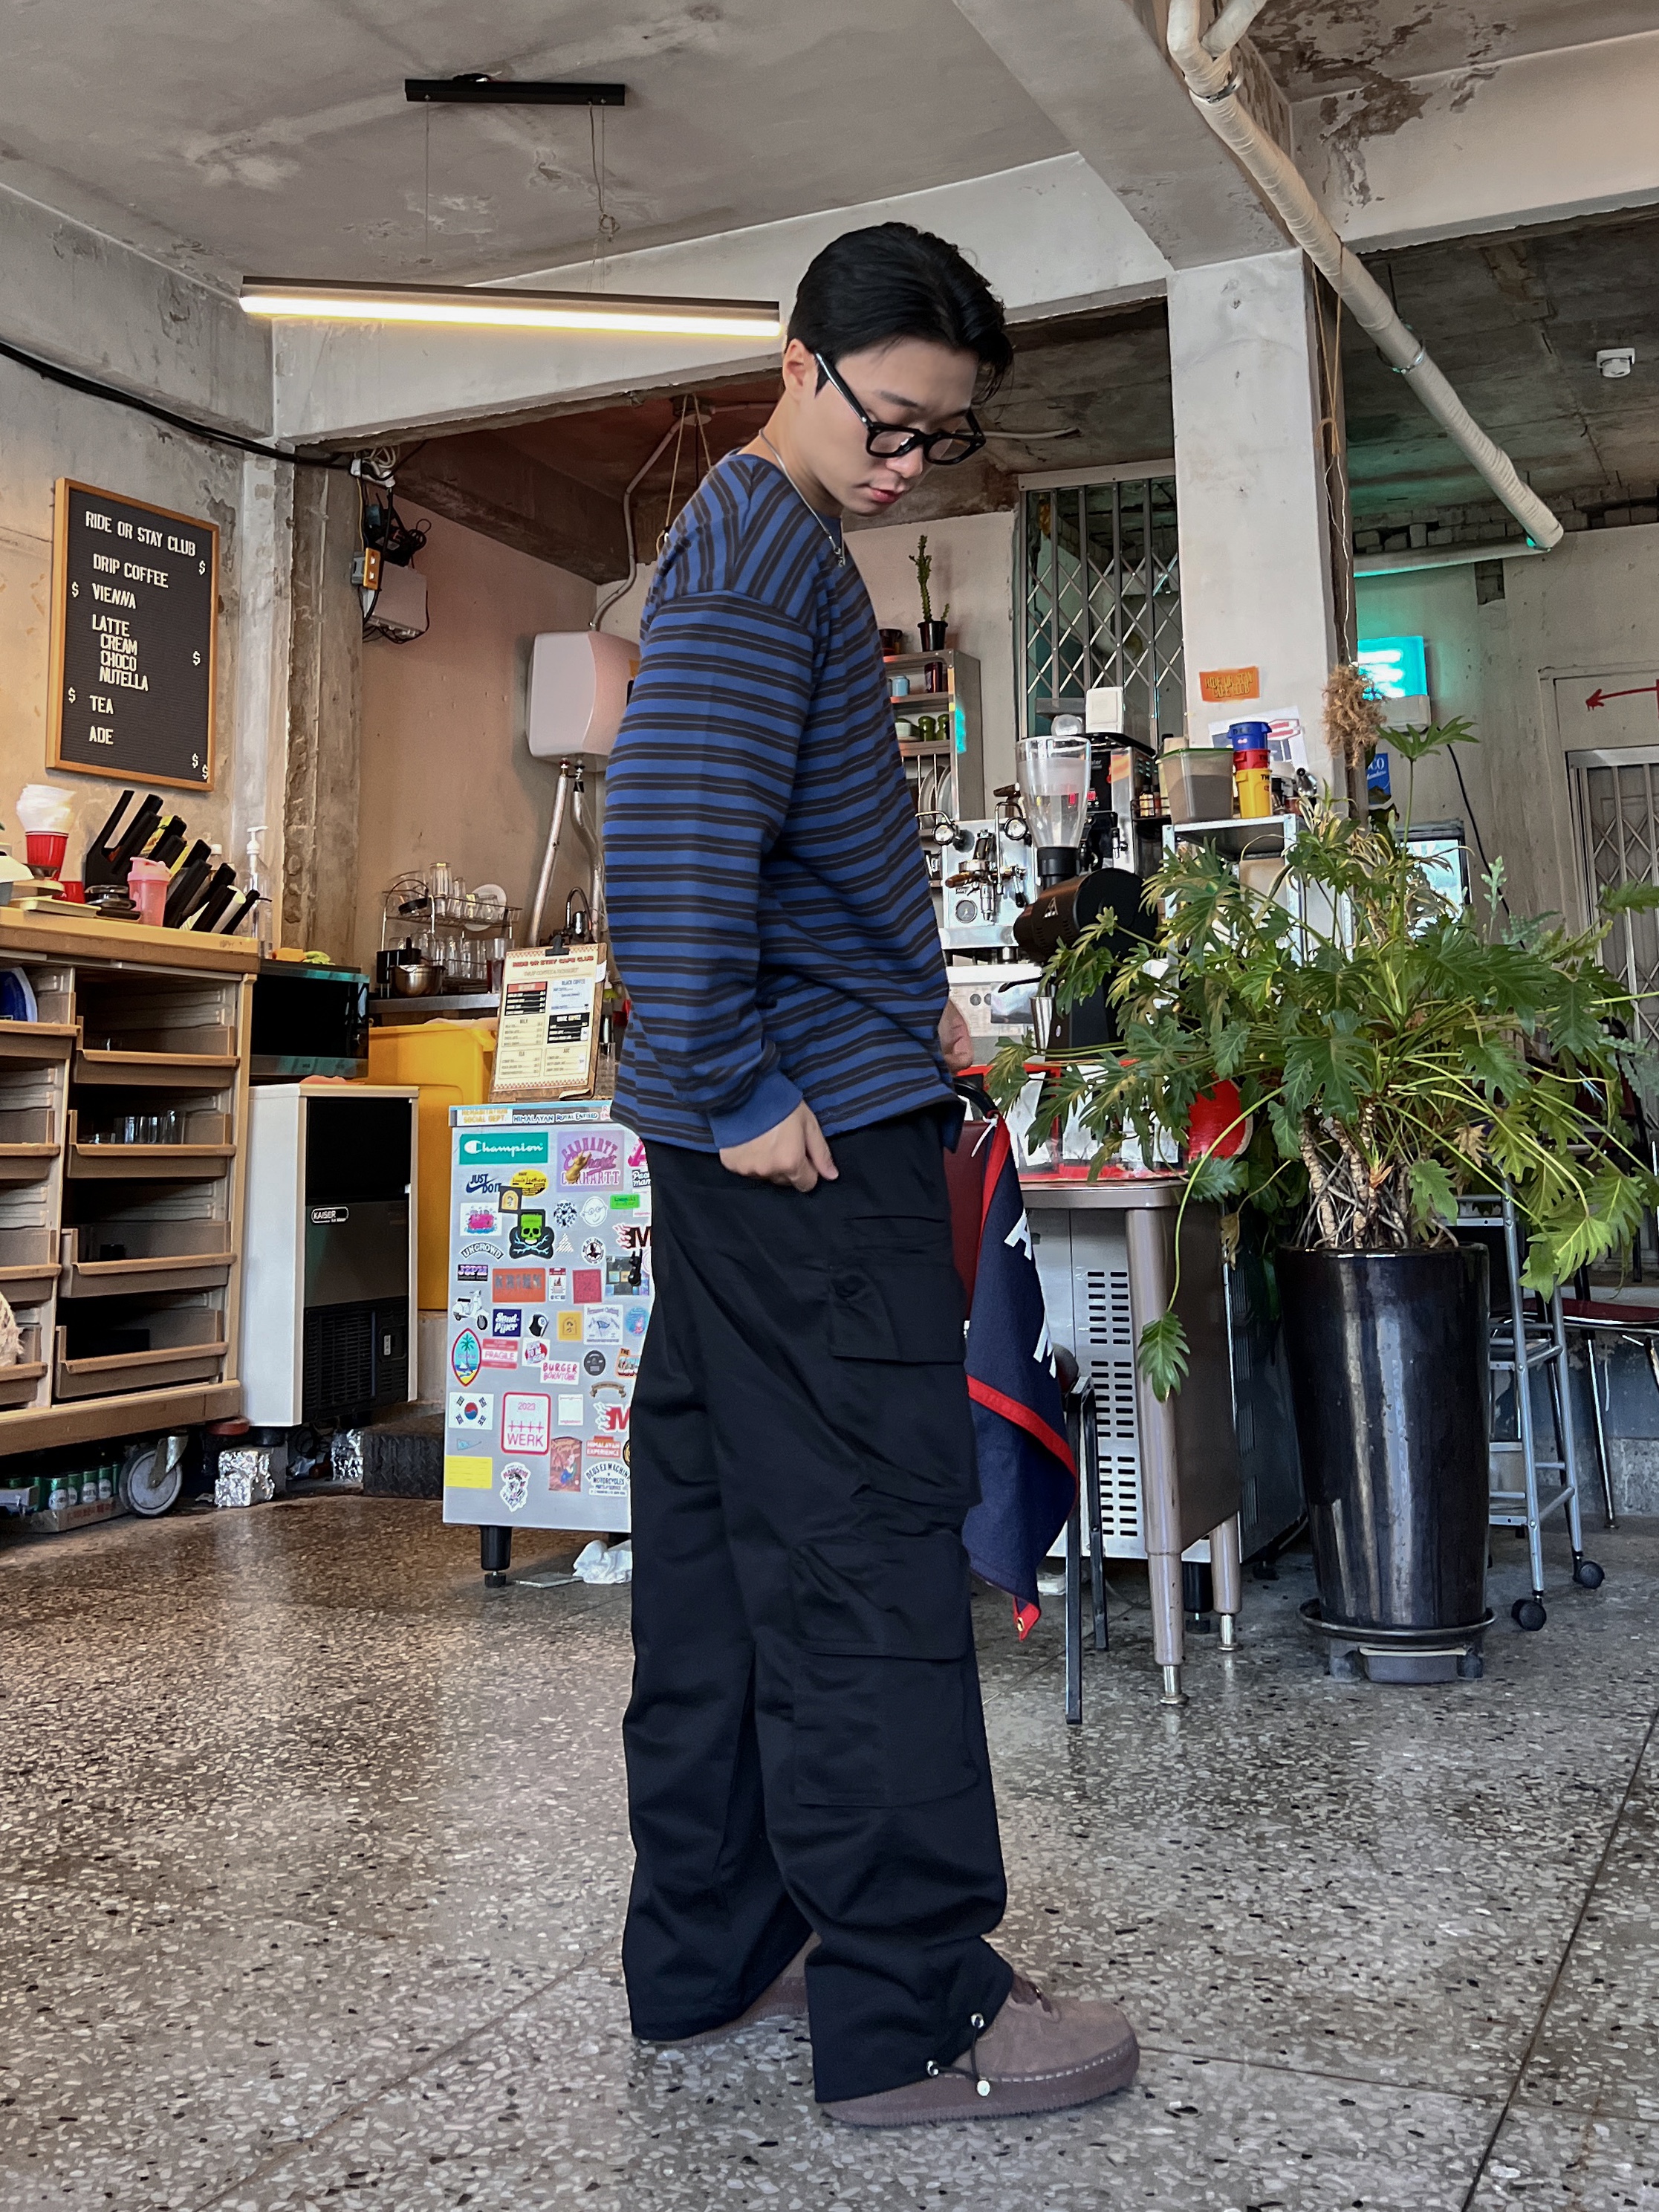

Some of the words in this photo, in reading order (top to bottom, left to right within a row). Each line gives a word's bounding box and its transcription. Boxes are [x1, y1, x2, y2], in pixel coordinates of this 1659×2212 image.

[85, 510, 112, 533] RIDE
[117, 520, 133, 539] OR
[137, 526, 163, 548] STAY
[167, 536, 196, 557] CLUB
[94, 554, 120, 575] DRIP
[123, 562, 169, 588] COFFEE
[198, 560, 206, 575] $
[71, 581, 79, 597] $
[92, 583, 137, 609] VIENNA
[92, 614, 130, 638] LATTE
[100, 634, 137, 655] CREAM
[100, 650, 137, 672] CHOCO
[192, 651, 201, 666] $
[100, 666, 149, 692] NUTELLA
[68, 687, 76, 704] $
[89, 695, 114, 715] TEA
[89, 725, 114, 745] ADE
[192, 753, 199, 768] $
[464, 1115, 485, 1123] SOCIAL
[513, 1115, 553, 1123] HIMALAYAN
[464, 1140, 543, 1157] Champion
[470, 1173, 489, 1184] JUST
[482, 1184, 493, 1193] DO
[314, 1210, 336, 1219] KAISER
[462, 1243, 502, 1259] UNCROWD
[485, 1351, 514, 1360] FRAGILE
[543, 1363, 577, 1373] BURGER
[507, 1433, 544, 1447] WERK
[586, 1466, 600, 1479] DEUS
